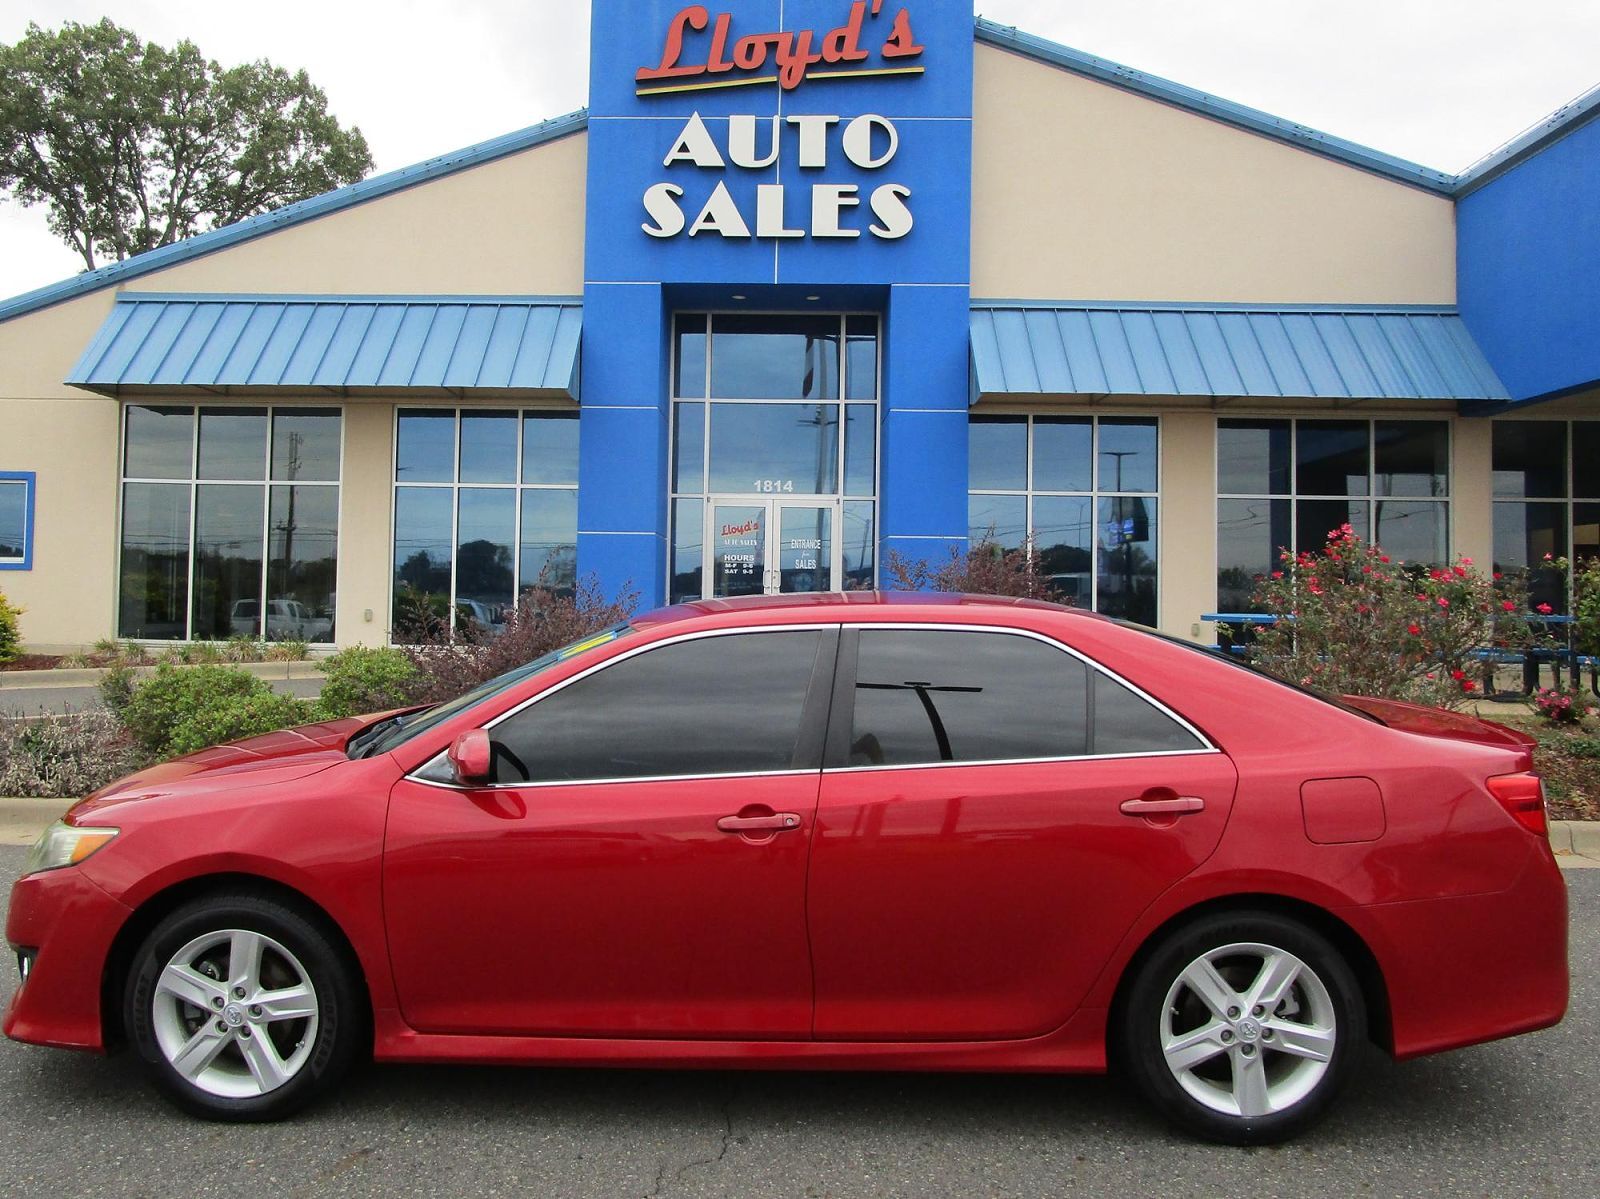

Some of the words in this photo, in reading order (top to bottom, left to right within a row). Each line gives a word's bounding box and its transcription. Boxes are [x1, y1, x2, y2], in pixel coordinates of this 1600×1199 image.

[635, 0, 924, 91] Lloyd's
[663, 111, 898, 169] AUTO
[641, 180, 913, 239] SALES
[754, 480, 793, 492] 1814
[721, 521, 759, 535] Lloyd's
[791, 539, 821, 549] ENTRANCE
[795, 559, 816, 569] SALES
